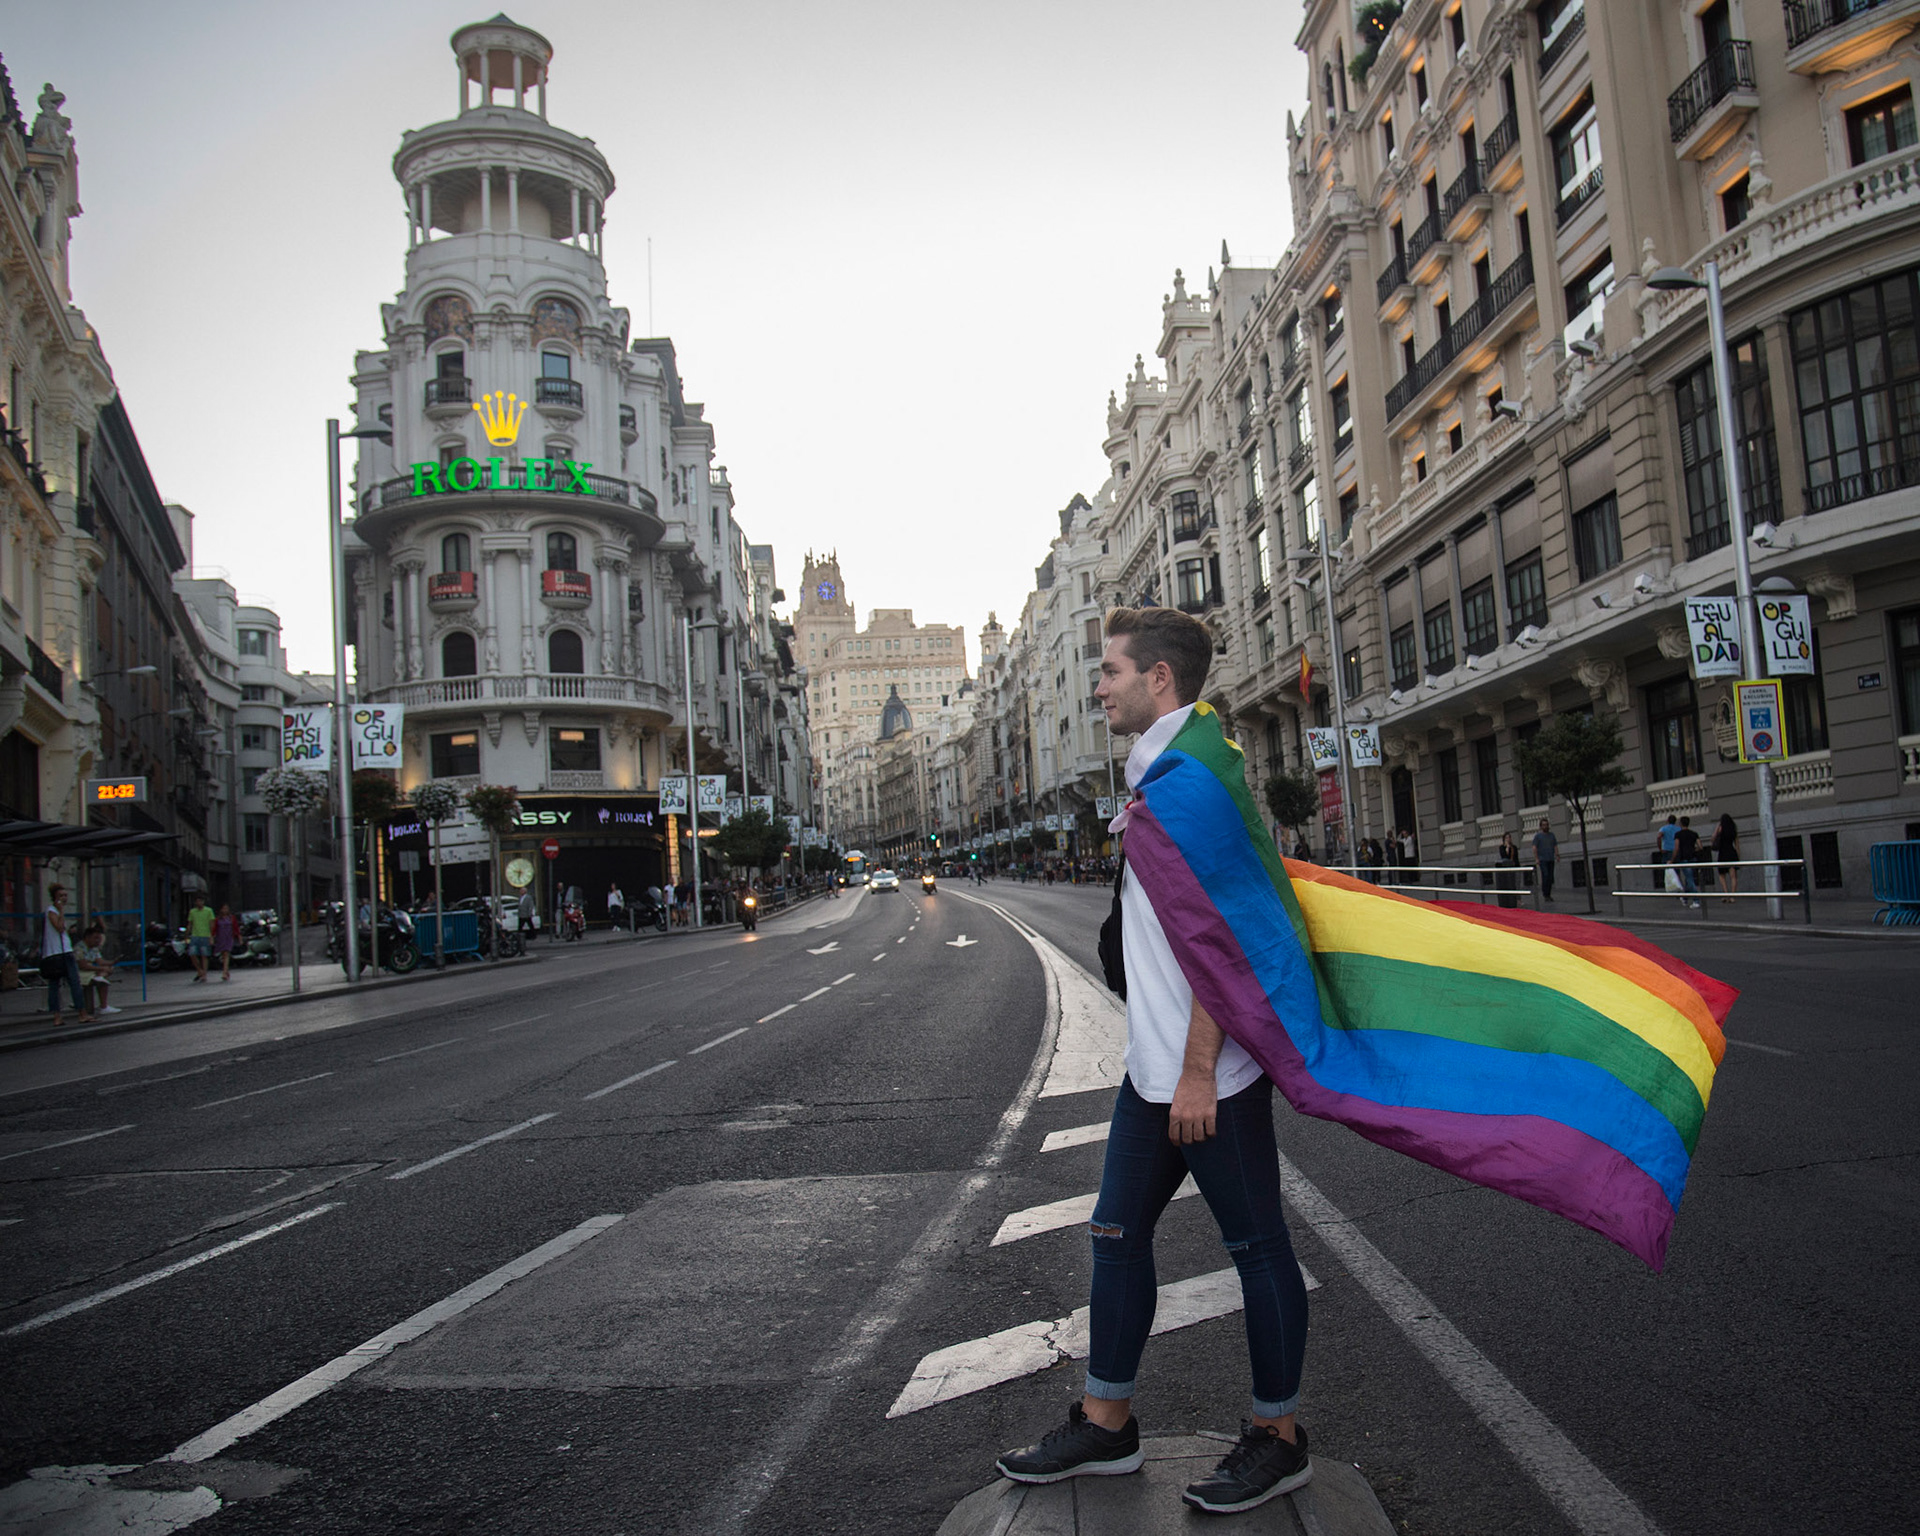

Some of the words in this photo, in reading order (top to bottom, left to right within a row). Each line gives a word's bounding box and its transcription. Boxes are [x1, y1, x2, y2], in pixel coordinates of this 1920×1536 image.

[410, 456, 597, 496] ROLEX
[1689, 603, 1731, 623] IGU
[1763, 602, 1793, 621] OR
[1704, 623, 1732, 642] AL
[1776, 621, 1805, 641] GU
[1696, 642, 1740, 664] DAD
[1773, 641, 1809, 660] LLO
[284, 711, 313, 729] DIV
[355, 709, 385, 726] OR
[364, 724, 394, 741] GU
[1309, 731, 1326, 742] DIV
[284, 744, 324, 763] DAD
[358, 740, 397, 757] LLO
[98, 783, 135, 799] 21:32
